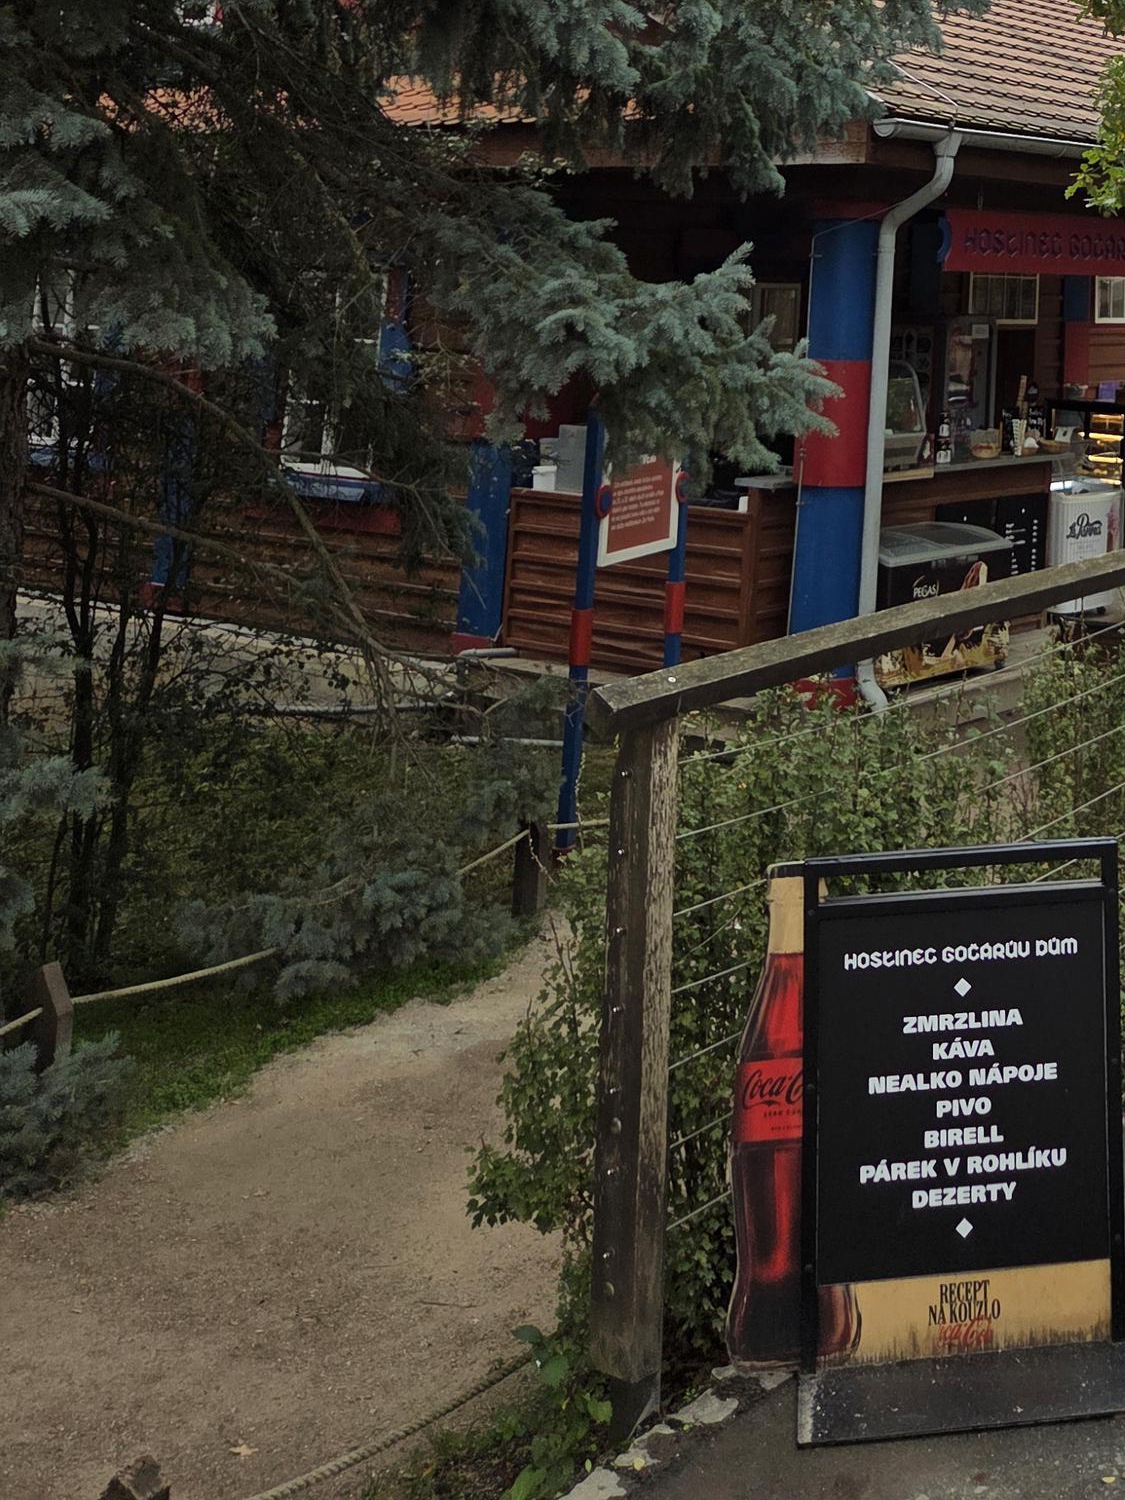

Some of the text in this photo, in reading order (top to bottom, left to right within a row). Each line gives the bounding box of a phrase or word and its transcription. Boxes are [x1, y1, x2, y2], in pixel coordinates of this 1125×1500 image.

[913, 584, 936, 598] PEGAS
[903, 1009, 1023, 1033] ZMRZLINA
[933, 1037, 994, 1060] KÁVA
[869, 1063, 1057, 1094] NEALKO NÁPOJE
[937, 1097, 991, 1118] PIVO
[924, 1125, 1004, 1148] BIRELL
[860, 1146, 1066, 1184] PÁREK V ROHLÍKU
[912, 1181, 1016, 1208] DEZERTY
[940, 1280, 990, 1304] RECEPT
[929, 1298, 1001, 1326] NA KOUZLO
